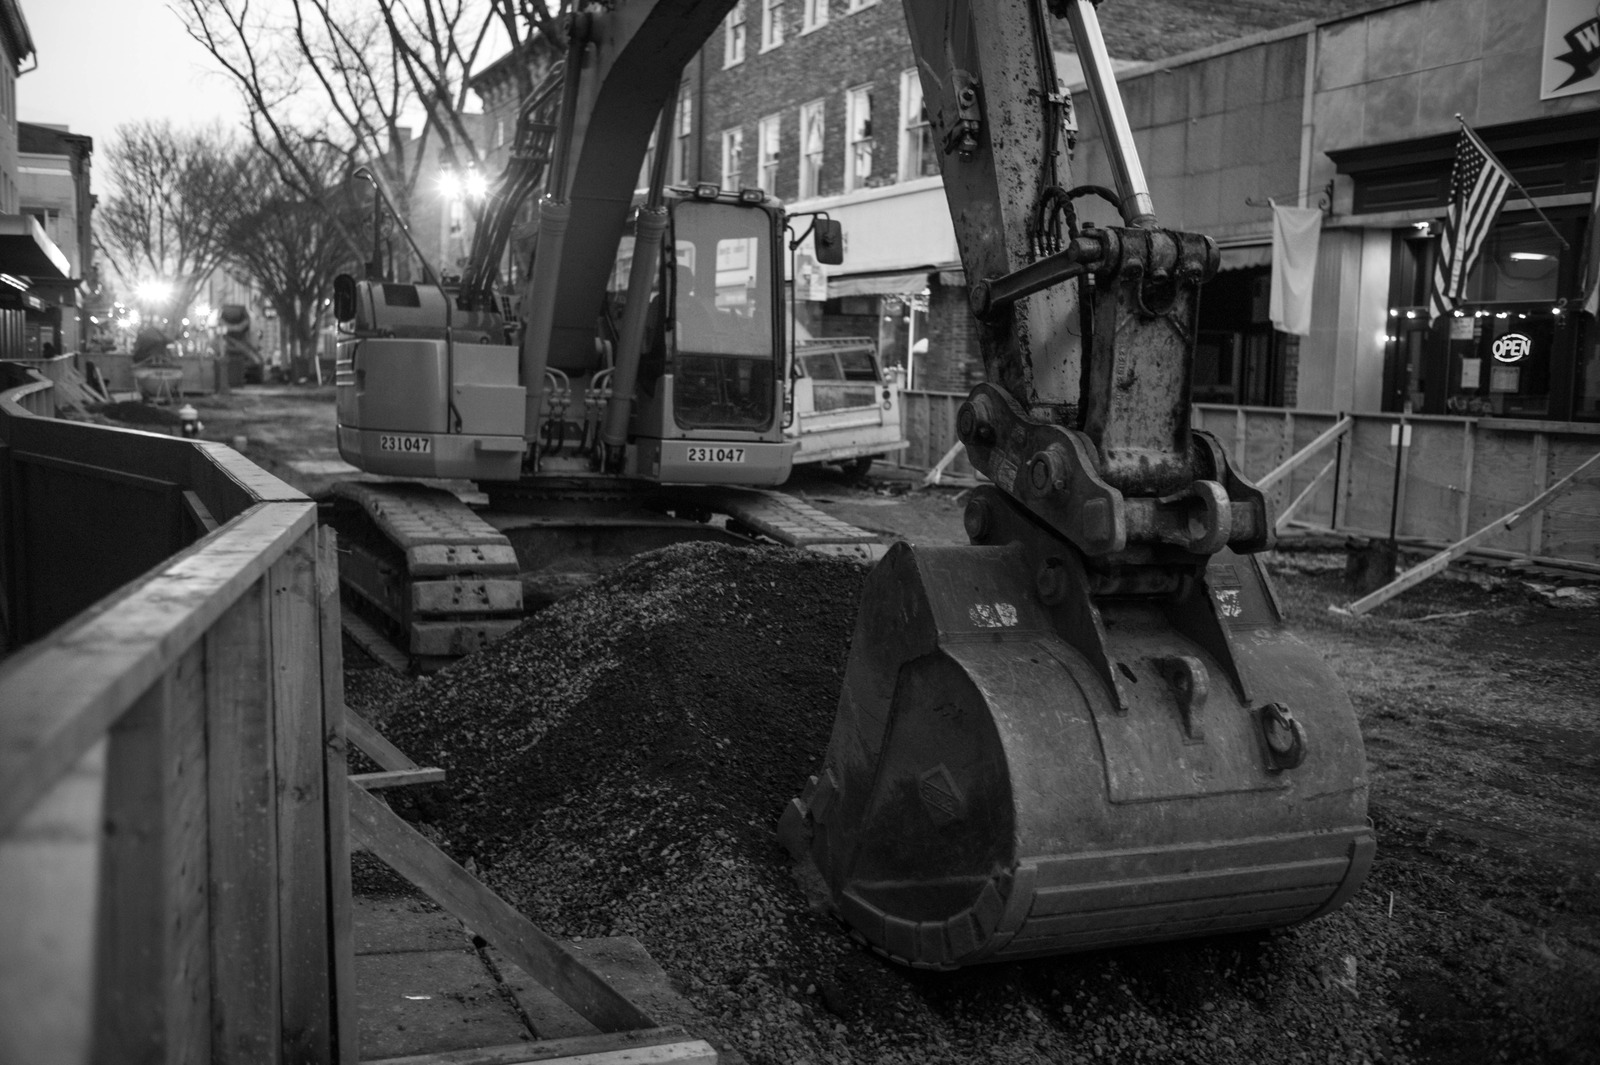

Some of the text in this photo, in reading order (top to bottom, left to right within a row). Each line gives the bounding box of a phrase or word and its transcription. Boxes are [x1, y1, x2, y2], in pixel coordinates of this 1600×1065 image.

[1492, 340, 1532, 356] OPEN
[381, 436, 429, 452] 231047
[688, 448, 744, 462] 231047
